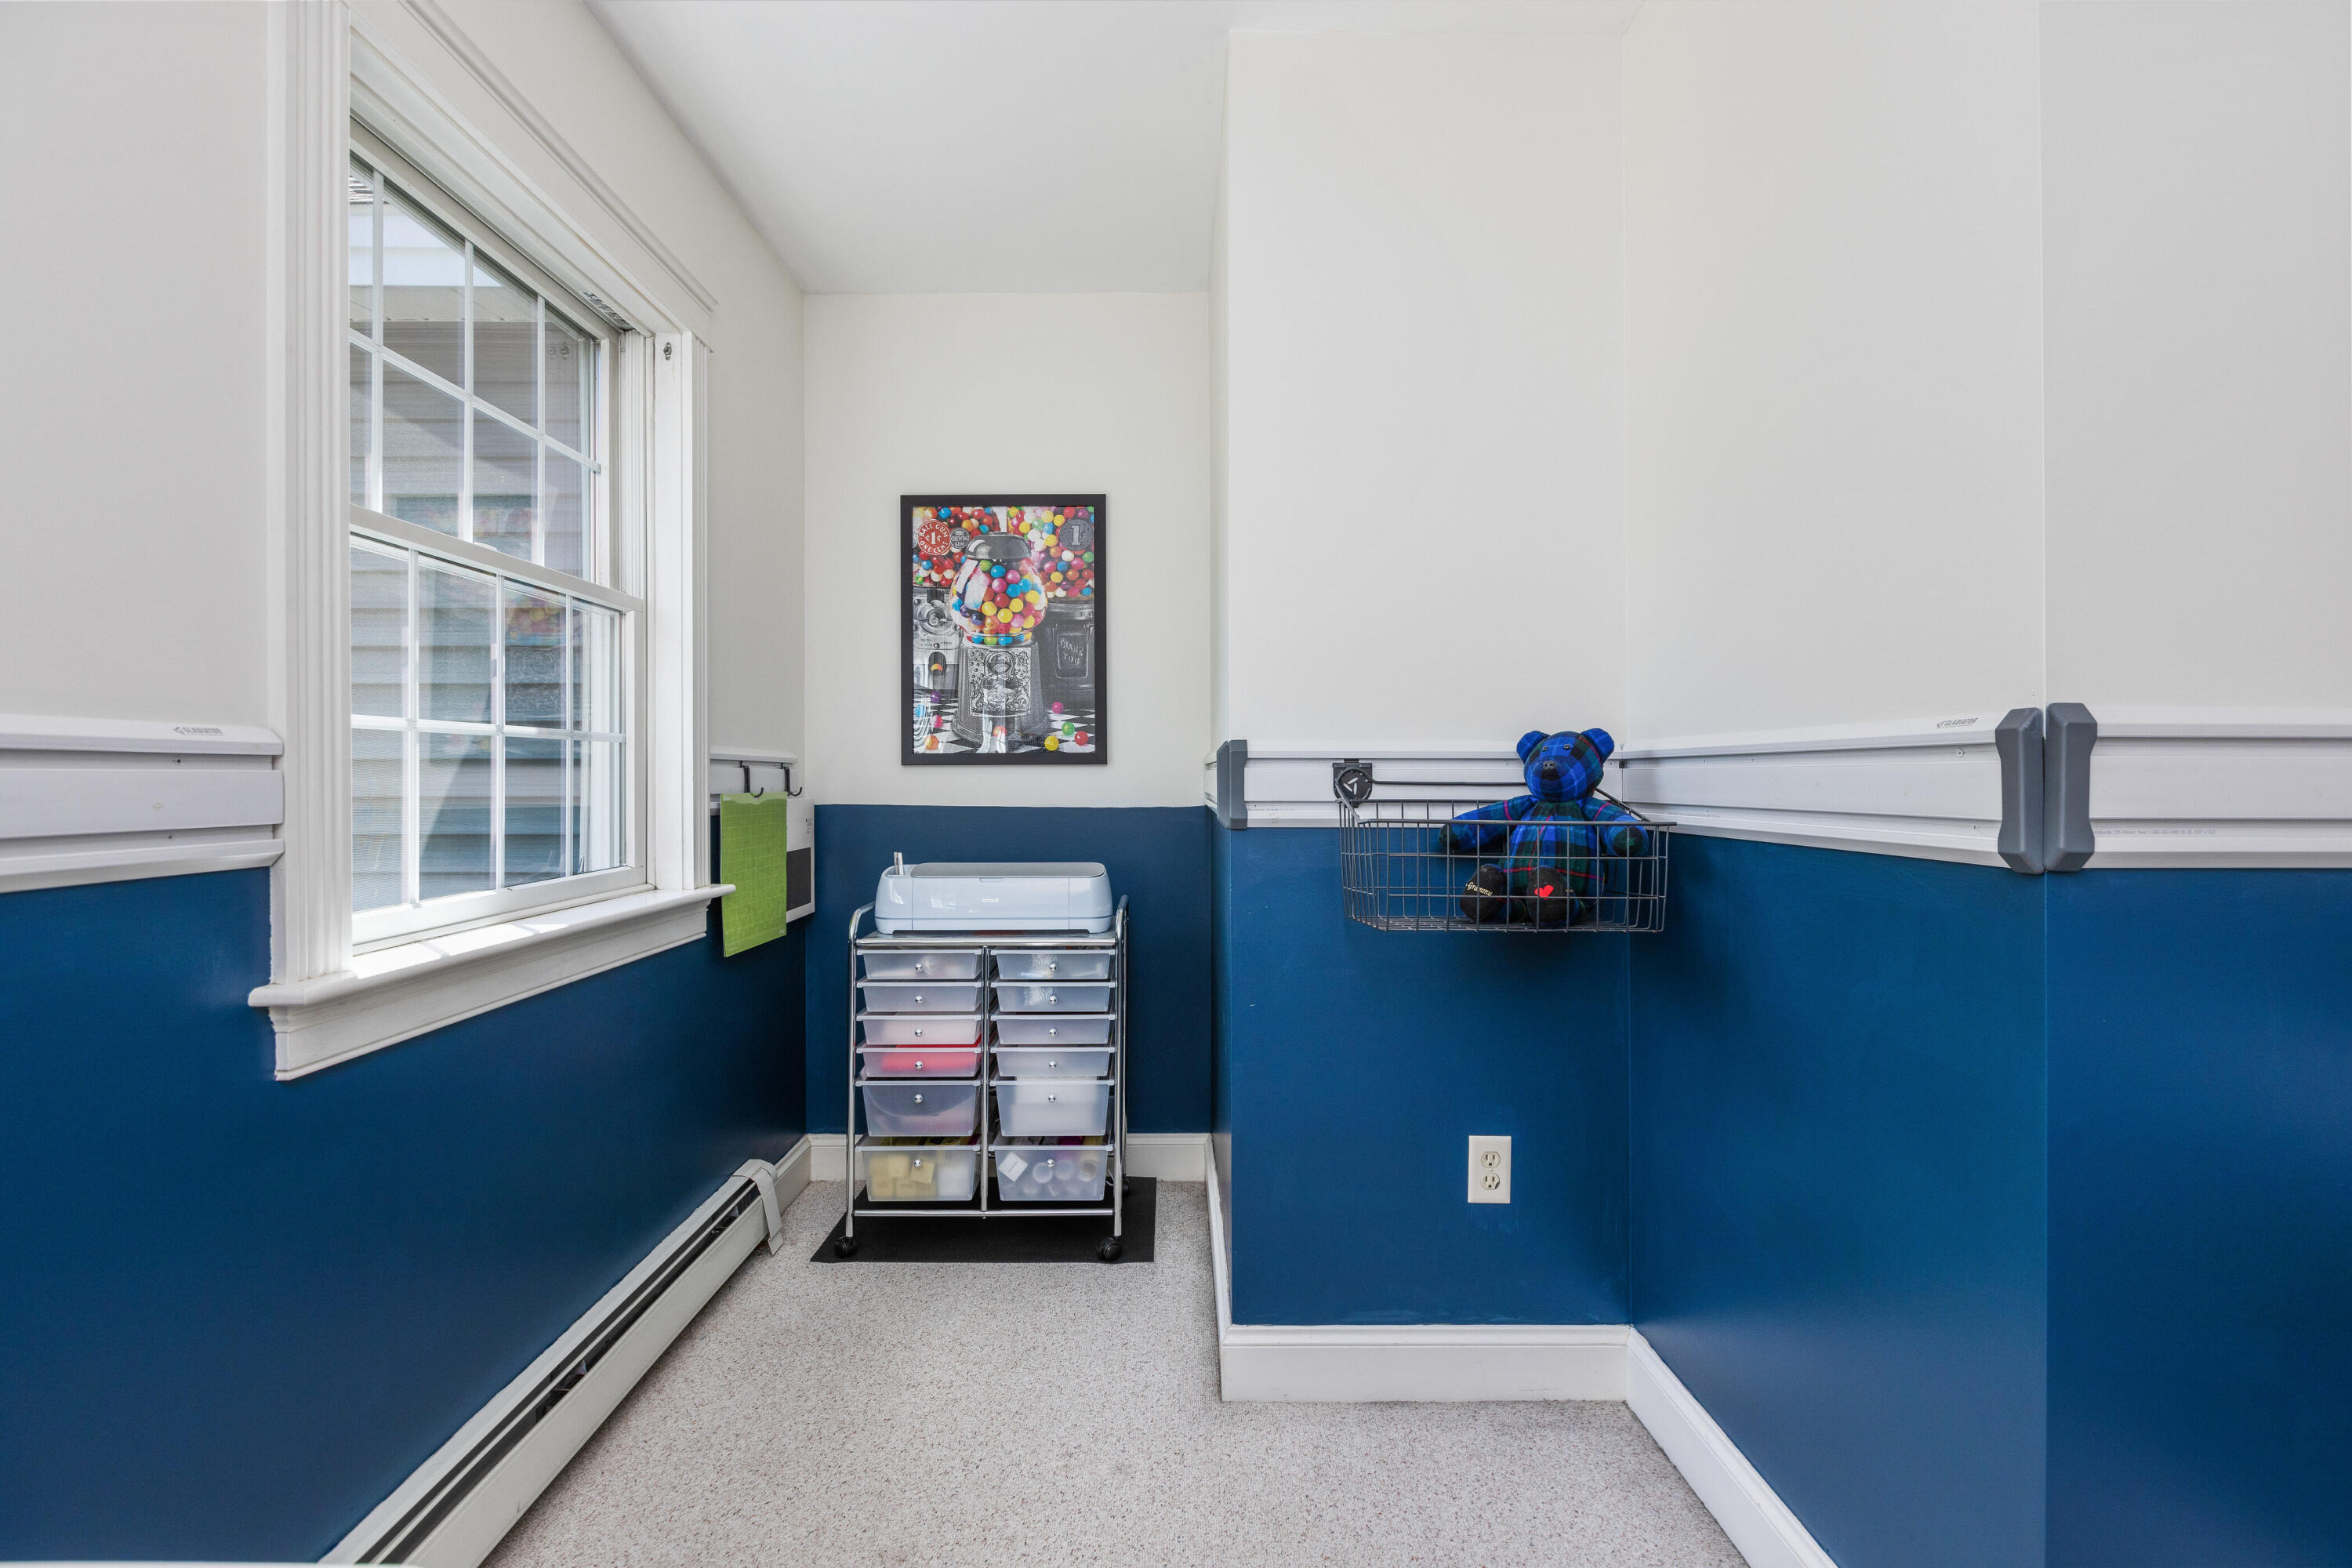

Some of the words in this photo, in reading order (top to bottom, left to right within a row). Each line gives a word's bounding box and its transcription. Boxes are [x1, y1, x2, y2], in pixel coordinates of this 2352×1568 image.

[919, 524, 934, 537] BALL
[935, 524, 949, 537] GUM
[920, 541, 932, 553] ONE
[933, 541, 948, 554] CENT
